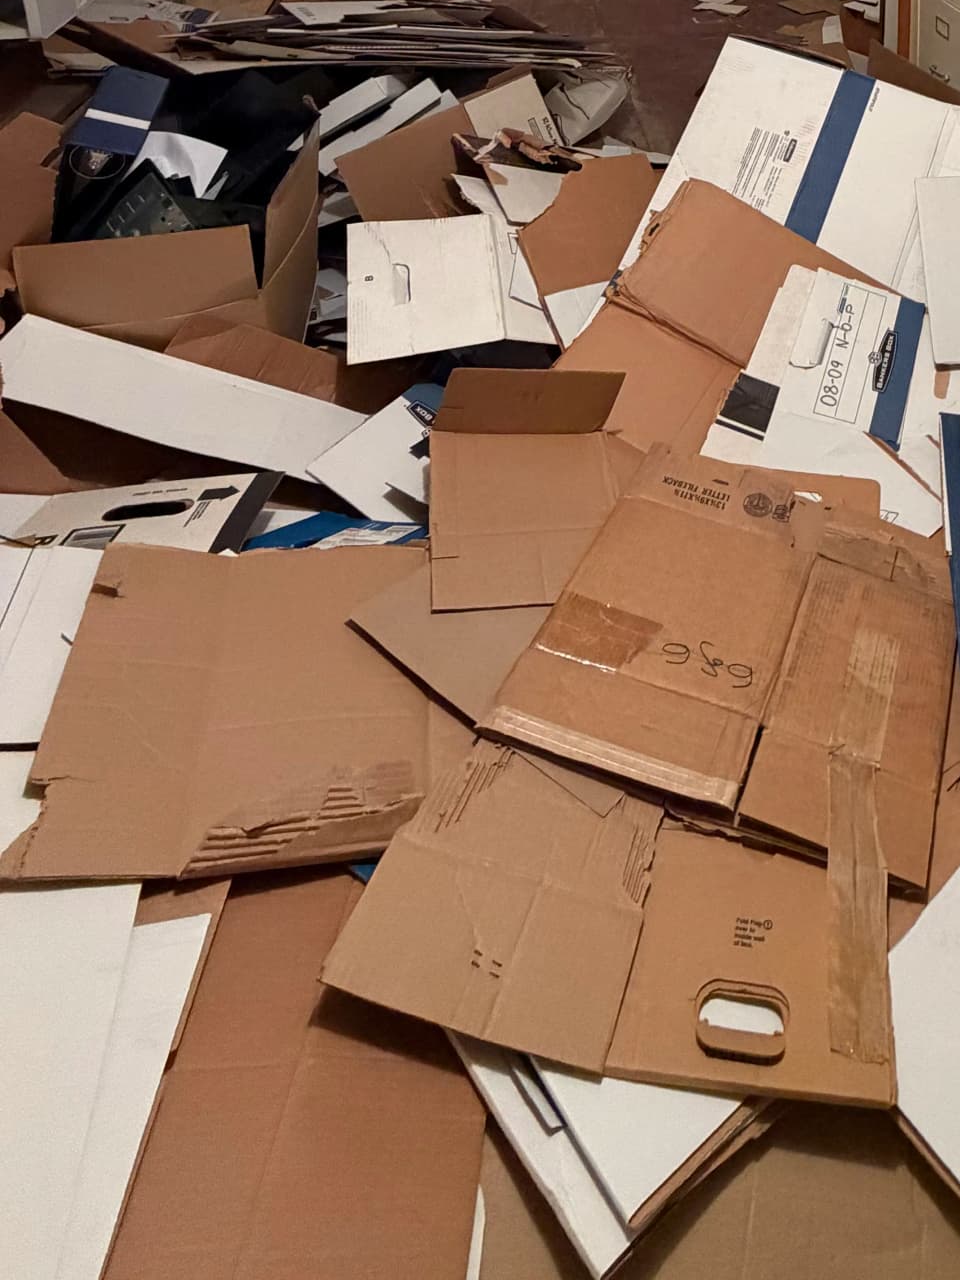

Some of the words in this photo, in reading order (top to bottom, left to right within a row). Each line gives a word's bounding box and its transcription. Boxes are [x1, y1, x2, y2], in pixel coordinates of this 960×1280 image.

[876, 352, 891, 389] BANKERS
[885, 335, 895, 352] BOX
[820, 360, 845, 407] 08-09
[415, 405, 433, 421] BOX
[702, 487, 731, 502] LETTER
